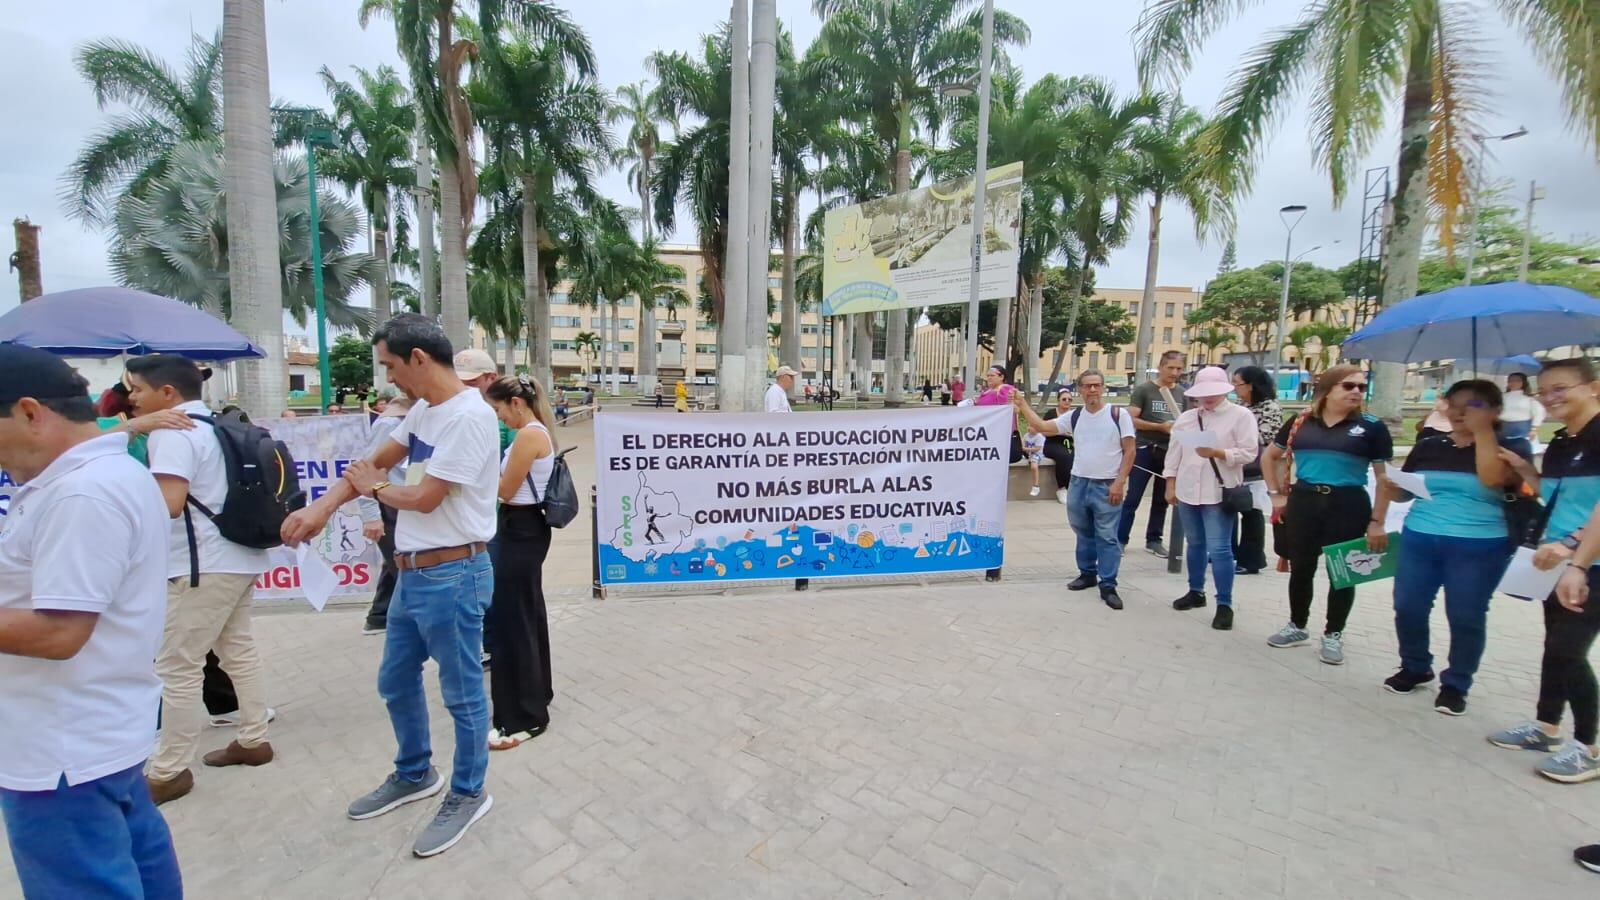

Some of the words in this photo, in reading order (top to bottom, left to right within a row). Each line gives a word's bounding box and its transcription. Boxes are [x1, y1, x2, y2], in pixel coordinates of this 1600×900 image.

[622, 434, 646, 450] EL
[652, 432, 747, 449] DERECHO
[795, 425, 907, 447] EDUCACIÓN
[911, 426, 988, 444] PUBLICA
[609, 456, 632, 471] ES
[636, 456, 660, 471] DE
[665, 450, 761, 470] GARANTÍA
[765, 453, 789, 468] DE
[793, 447, 902, 468] PRESTACIÓN
[906, 447, 1001, 463] INMEDIATA
[717, 481, 750, 499] NO
[755, 476, 802, 498] MÁS
[807, 477, 876, 495] BURLA
[881, 475, 934, 493] ALAS
[694, 504, 846, 525] COMUNIDADES
[849, 500, 967, 520] EDUCATIVAS
